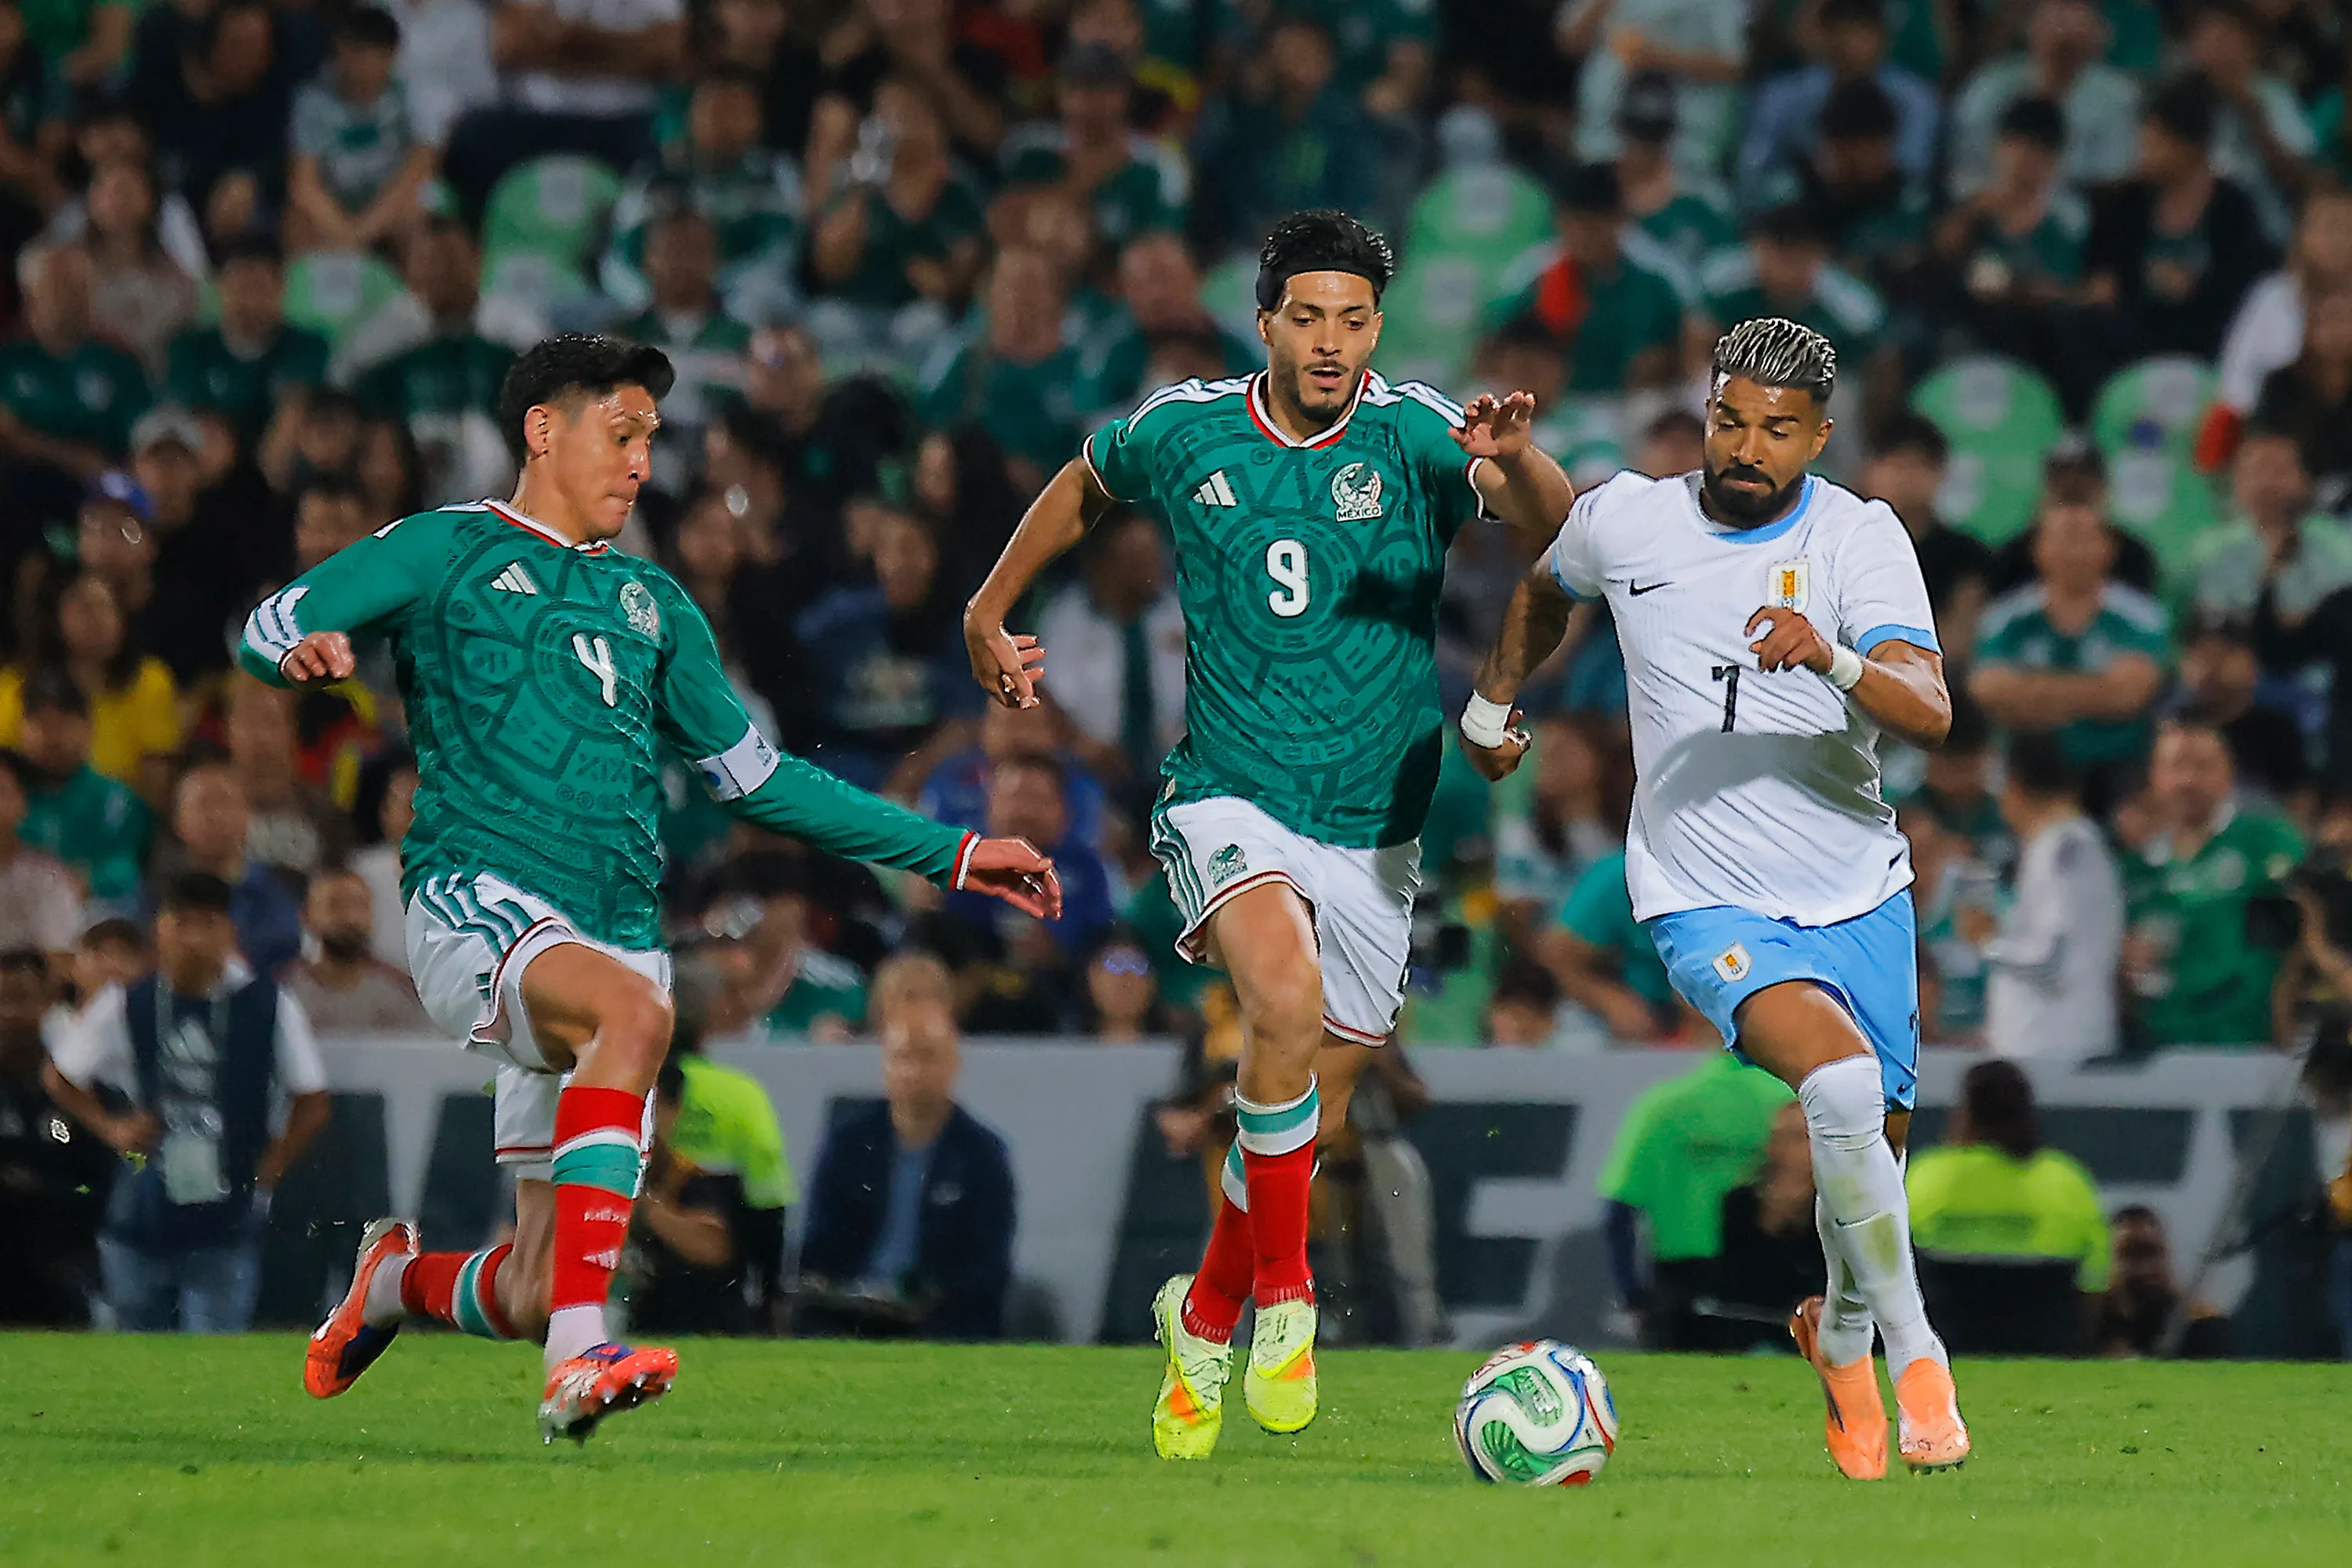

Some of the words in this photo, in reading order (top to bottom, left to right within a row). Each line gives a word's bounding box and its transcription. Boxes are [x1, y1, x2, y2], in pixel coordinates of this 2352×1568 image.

[1338, 507, 1380, 520] MÉXICO
[1267, 539, 1309, 618] 9
[572, 634, 618, 708] 4
